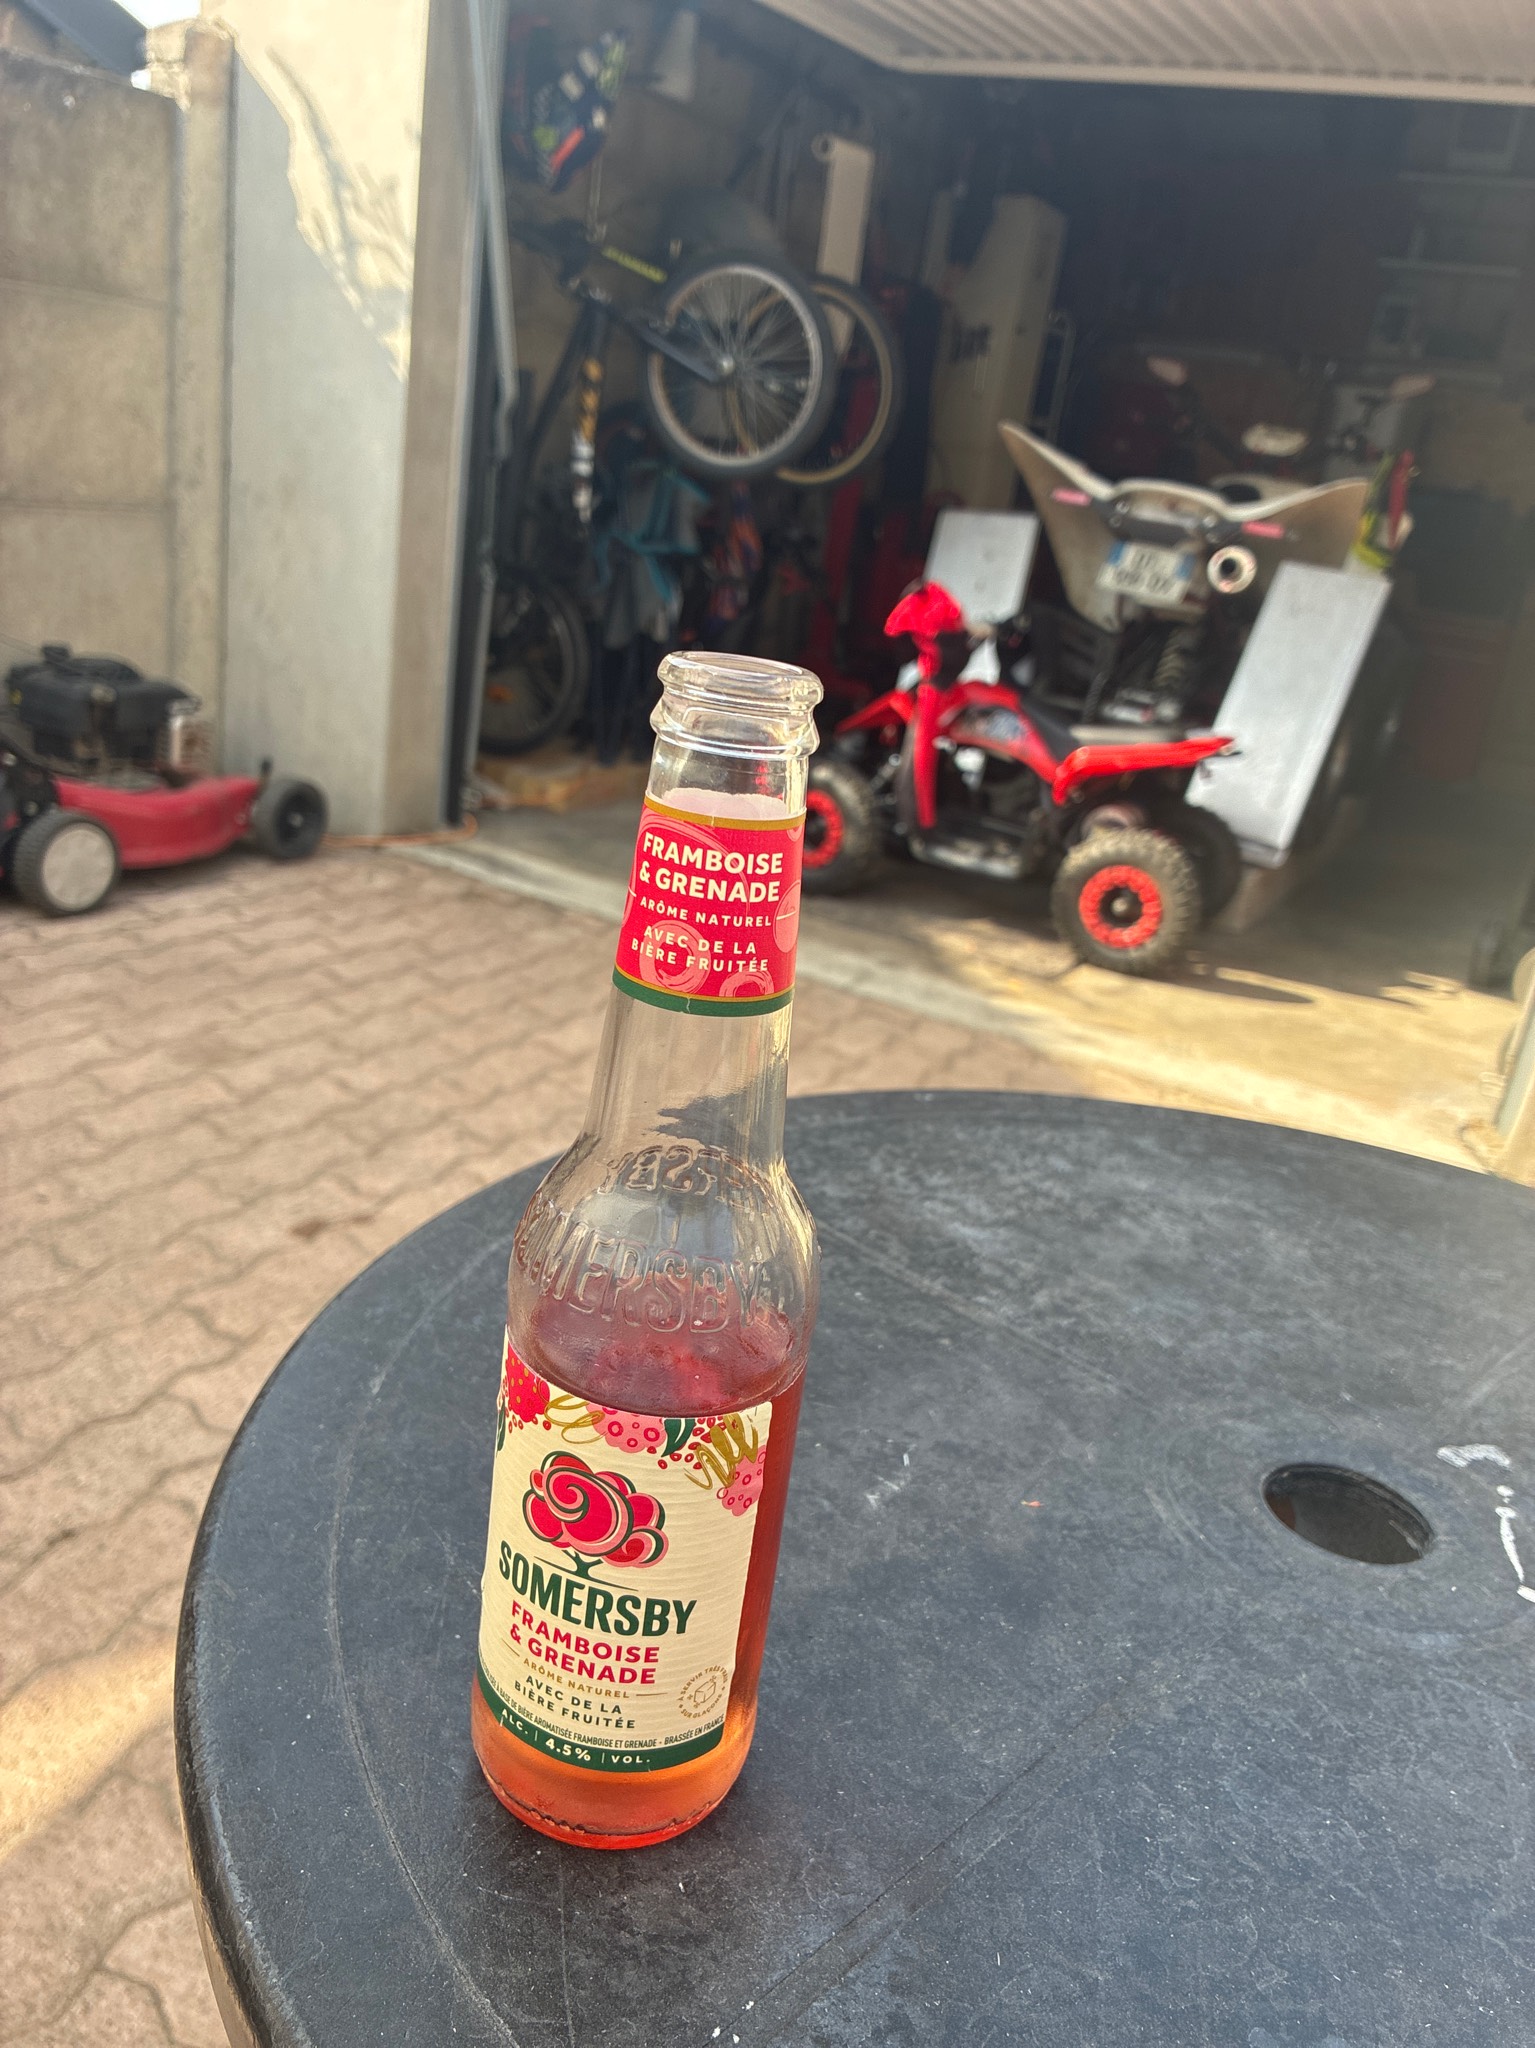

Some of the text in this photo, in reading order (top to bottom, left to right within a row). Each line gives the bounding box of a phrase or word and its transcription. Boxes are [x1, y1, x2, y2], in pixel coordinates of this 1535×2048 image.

[643, 831, 783, 875] FRAMBOISE
[639, 861, 781, 903] & GRENADE
[640, 896, 772, 928] ARÔME NATUREL
[631, 937, 769, 973] BIÈRE FRUITÉE
[644, 926, 757, 955] AVEC DE LA
[499, 1540, 698, 1637] SOMERSBY
[511, 1600, 660, 1664] FRAMBOISE
[510, 1623, 521, 1645] &
[528, 1637, 657, 1685] GRENADE
[523, 1657, 563, 1684] ARÔME
[568, 1680, 630, 1699] NATUREL
[526, 1675, 622, 1715] AVEC DE LA
[514, 1680, 636, 1729] BIÈRE FRUITÉE
[501, 1708, 650, 1764] ALC. 4.5% VOL.
[534, 1715, 573, 1740] AROMATISÉE
[573, 1732, 614, 1748] FRAMBOISE
[615, 1739, 624, 1748] ET
[624, 1738, 657, 1749] GRENADE
[664, 1728, 694, 1746] BRASSÉE
[694, 1725, 703, 1737] EN
[703, 1713, 725, 1732] FRANCE
